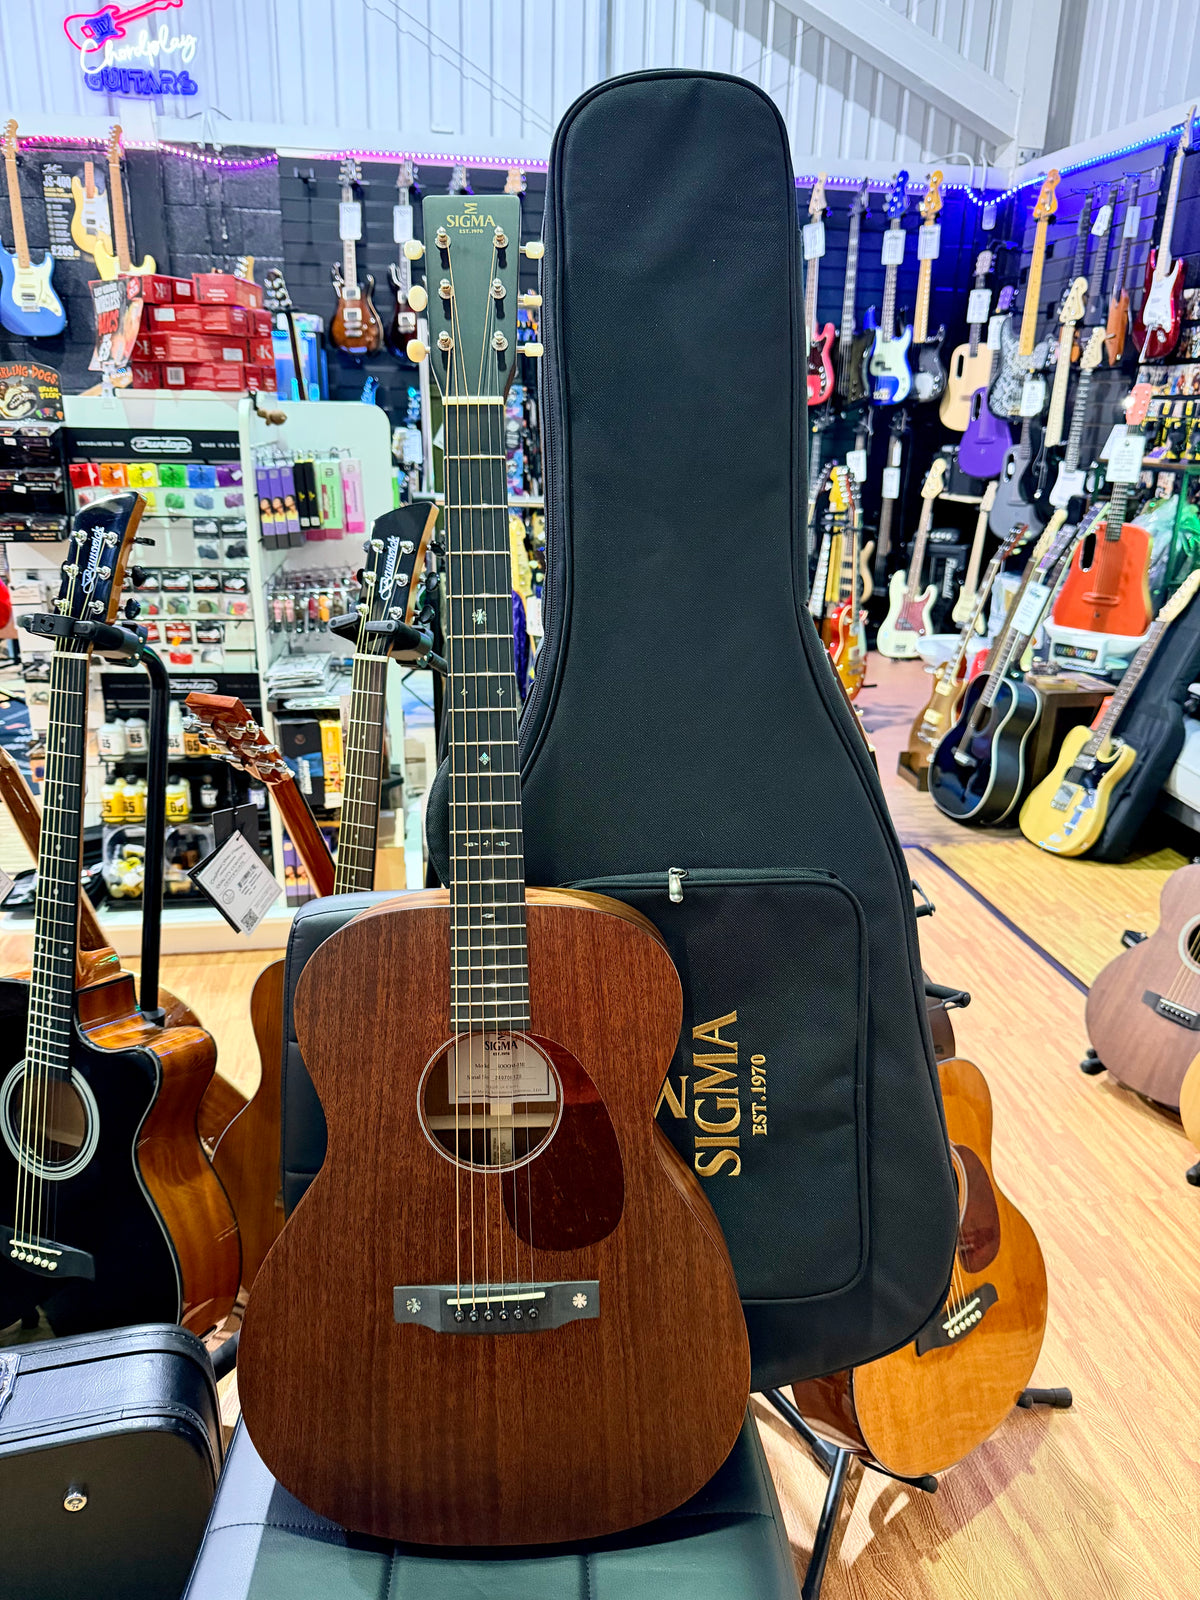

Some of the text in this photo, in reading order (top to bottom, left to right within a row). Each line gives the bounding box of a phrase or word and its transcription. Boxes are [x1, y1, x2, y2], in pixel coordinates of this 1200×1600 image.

[84, 66, 198, 95] GUITARS
[446, 214, 496, 227] SIGMA
[135, 440, 188, 451] Dunlop
[81, 525, 105, 594] Brunswick
[378, 535, 400, 600] Brunswick
[187, 740, 200, 752] 65
[484, 1040, 518, 1051] SIGMA
[692, 1010, 742, 1177] SIGMA
[751, 1053, 768, 1136] EST.1970
